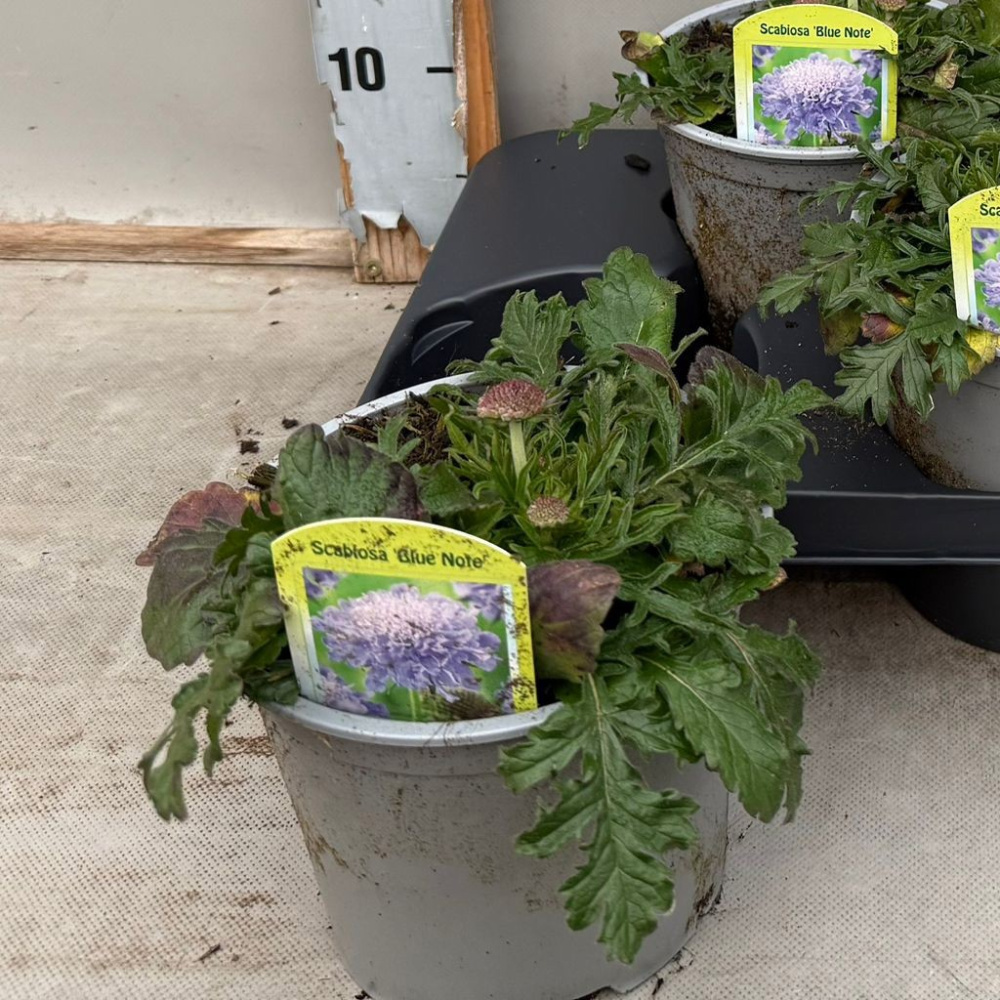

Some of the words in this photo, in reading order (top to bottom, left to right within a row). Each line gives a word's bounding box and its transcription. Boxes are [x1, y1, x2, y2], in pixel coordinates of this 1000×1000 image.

[759, 23, 810, 37] Scabiosa
[813, 26, 842, 38] 'Blue
[844, 27, 874, 39] Note'
[328, 46, 386, 92] 10
[310, 540, 388, 561] Scabiosa
